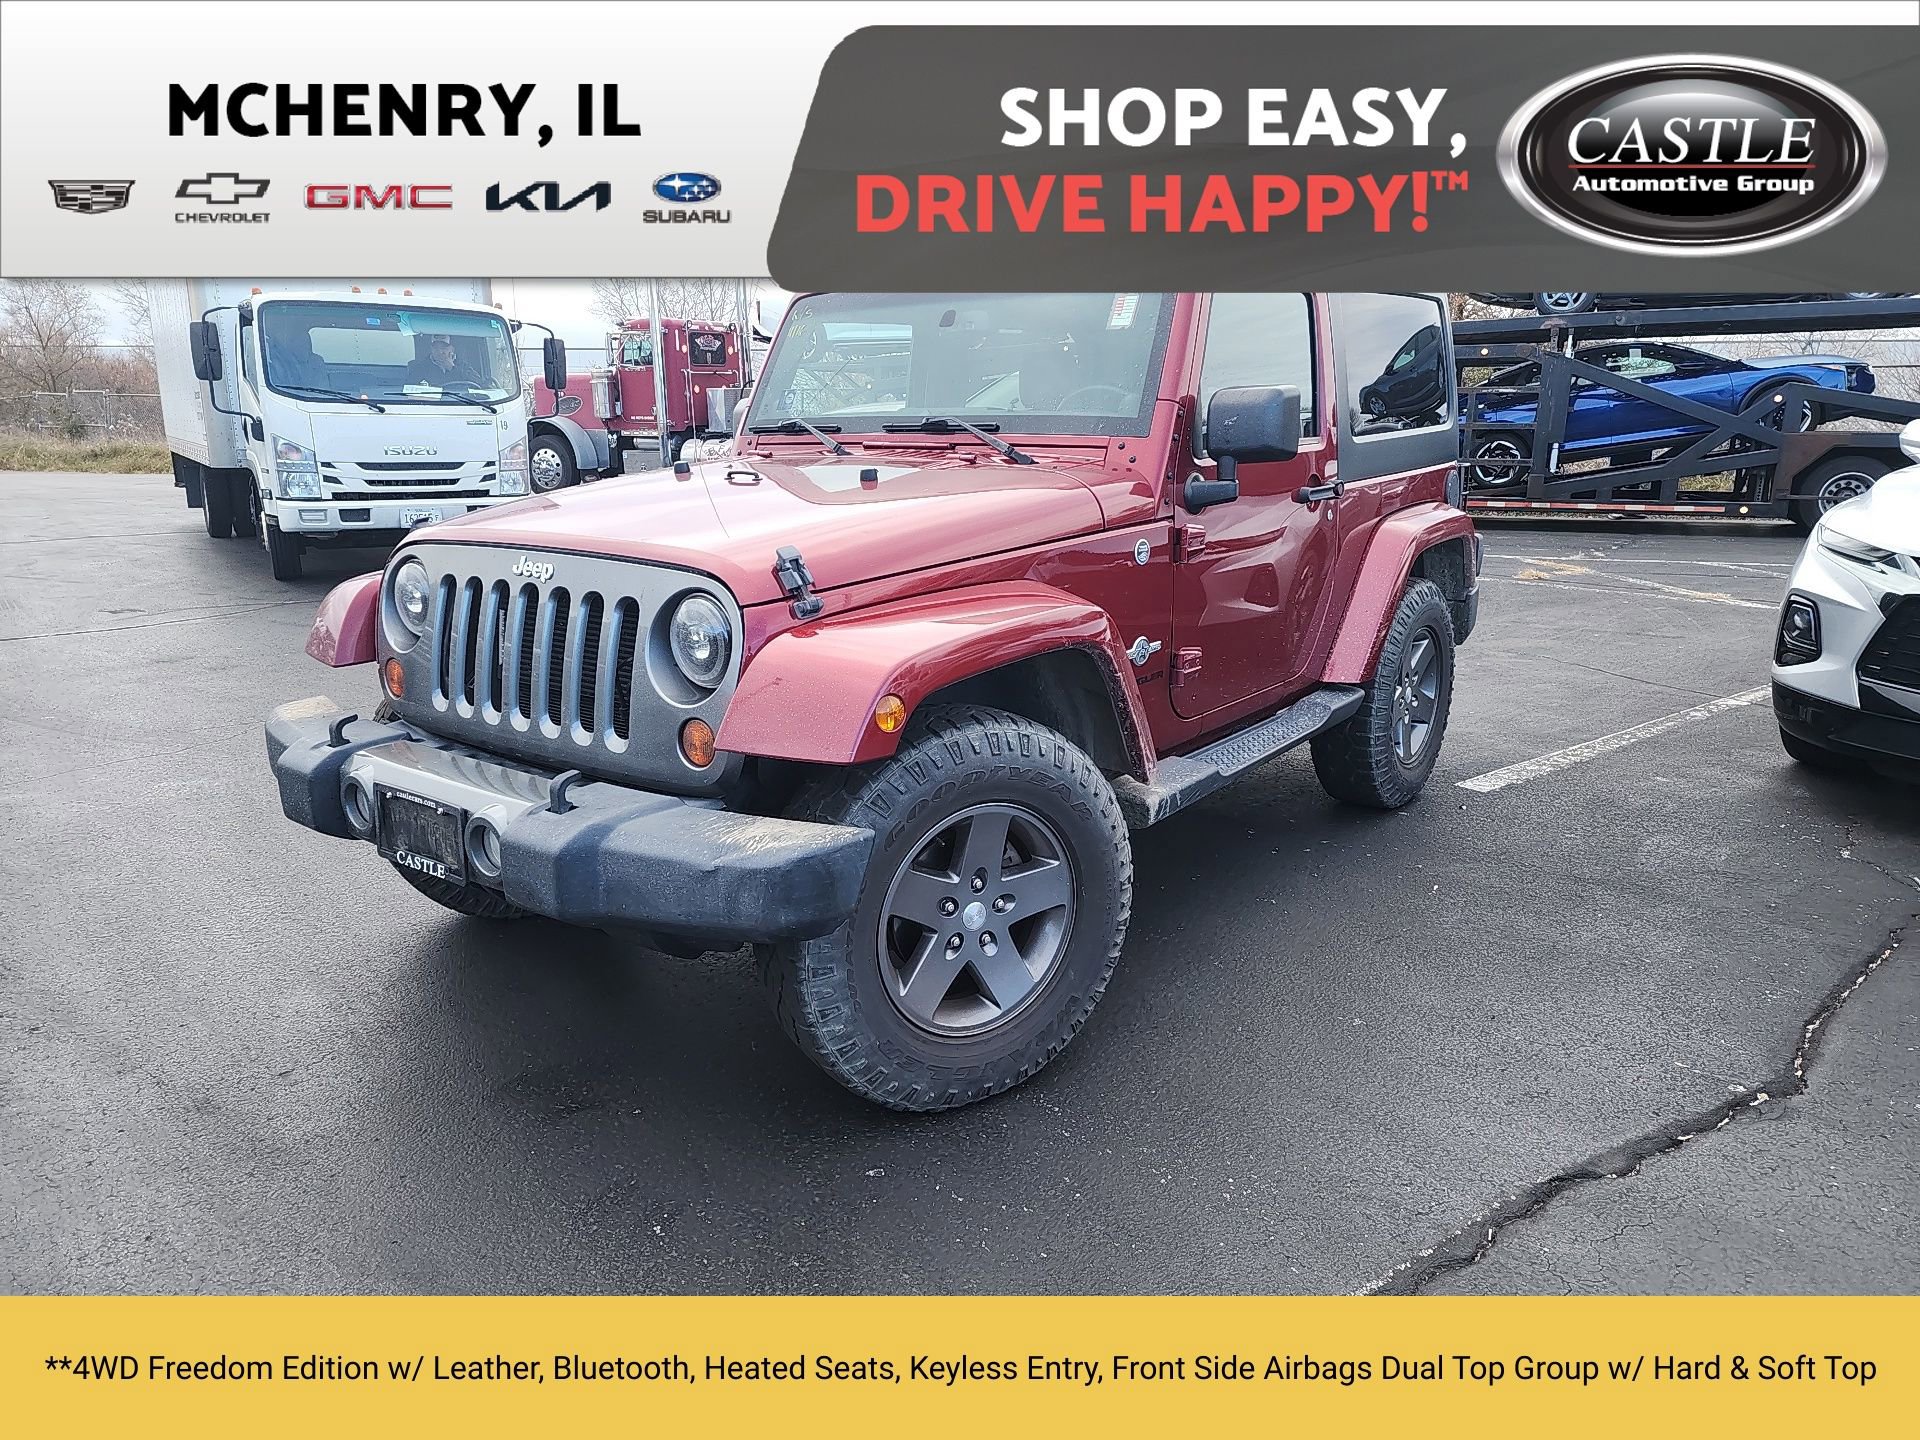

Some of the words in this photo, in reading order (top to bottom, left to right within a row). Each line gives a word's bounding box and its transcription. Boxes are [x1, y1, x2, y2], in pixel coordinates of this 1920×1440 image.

[383, 445, 438, 456] ISUZU
[512, 555, 554, 584] Jeep
[396, 850, 446, 880] CASTLE
